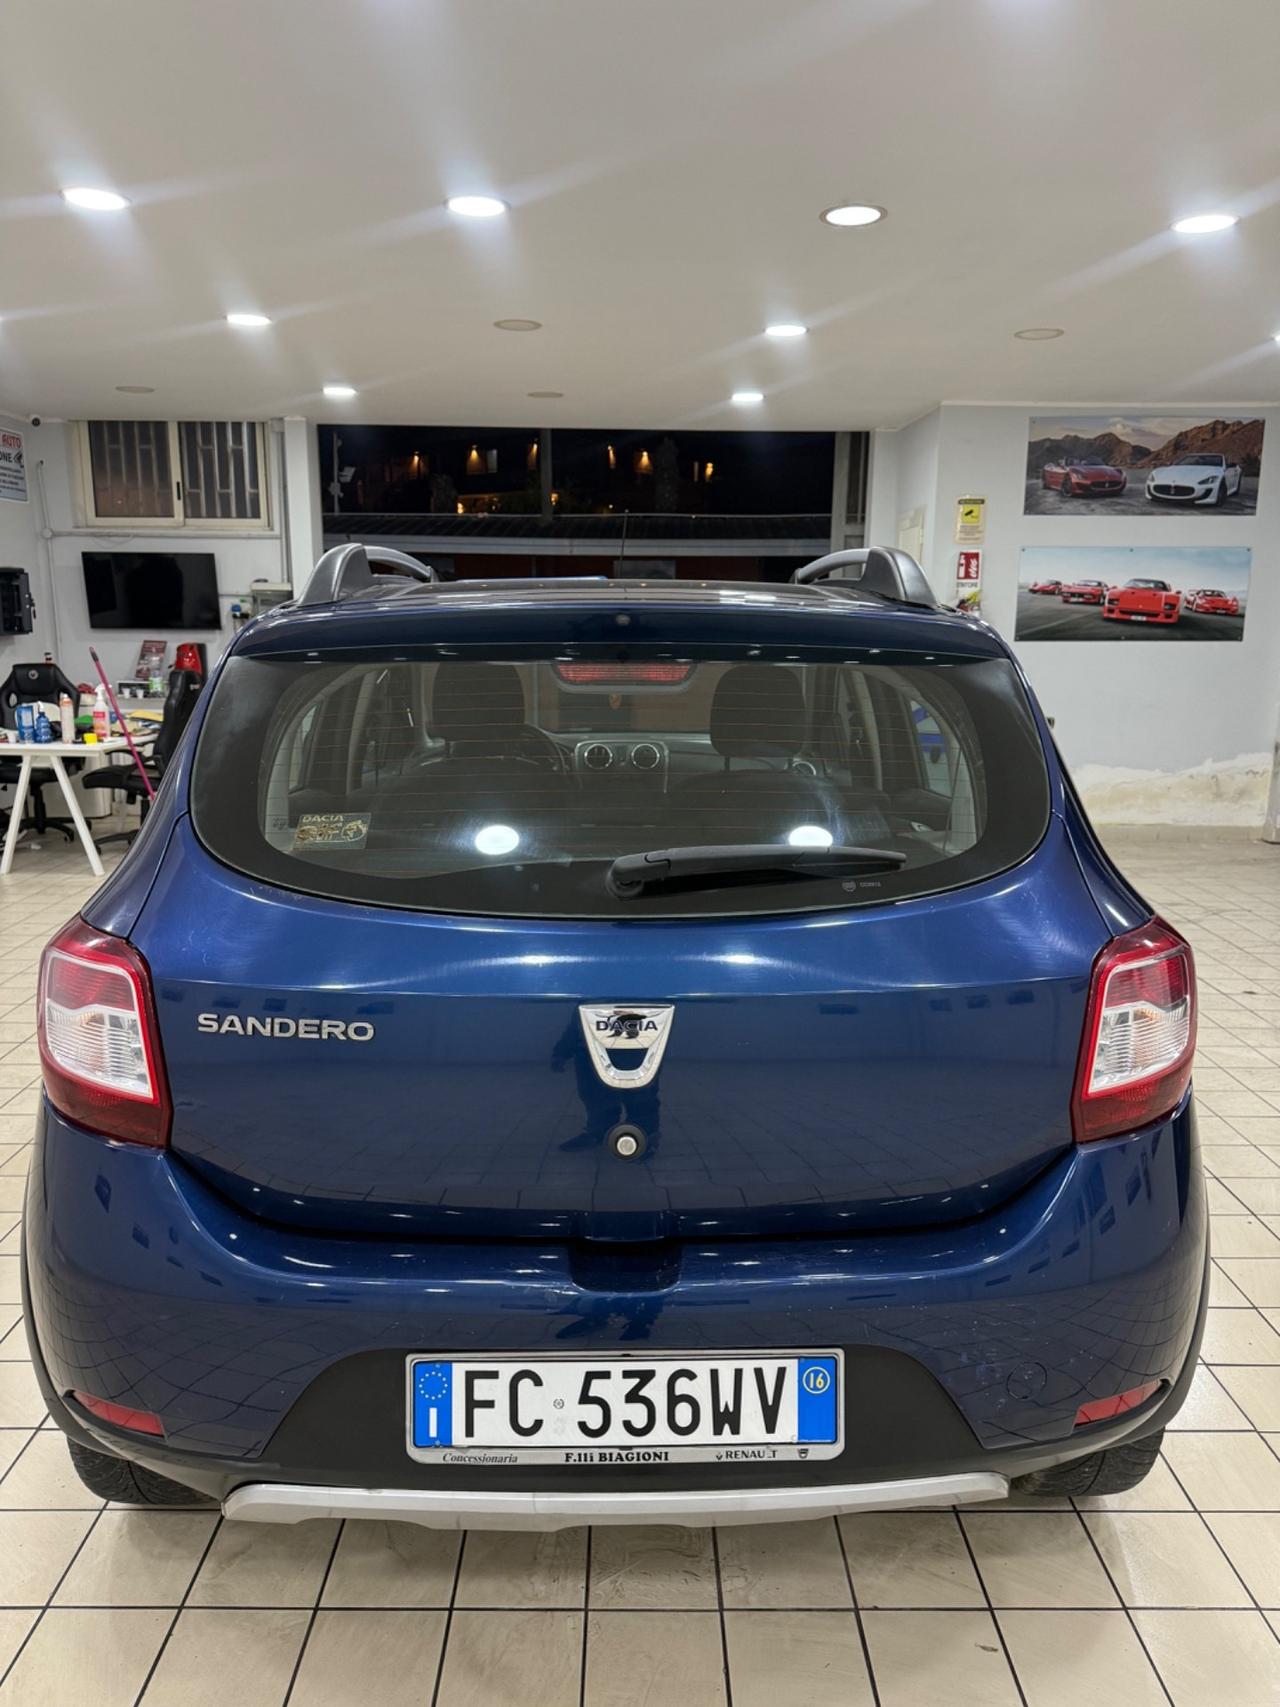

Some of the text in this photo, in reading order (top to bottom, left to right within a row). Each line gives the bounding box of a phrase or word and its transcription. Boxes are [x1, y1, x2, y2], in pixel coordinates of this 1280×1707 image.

[302, 815, 344, 823] DACIA
[197, 1013, 375, 1041] SANDERO
[596, 1020, 658, 1031] DACIA
[808, 1371, 826, 1389] 16
[464, 1366, 788, 1438] FC 536WV
[442, 1452, 518, 1464] Concessionaria
[597, 1451, 669, 1462] BIAGIONI
